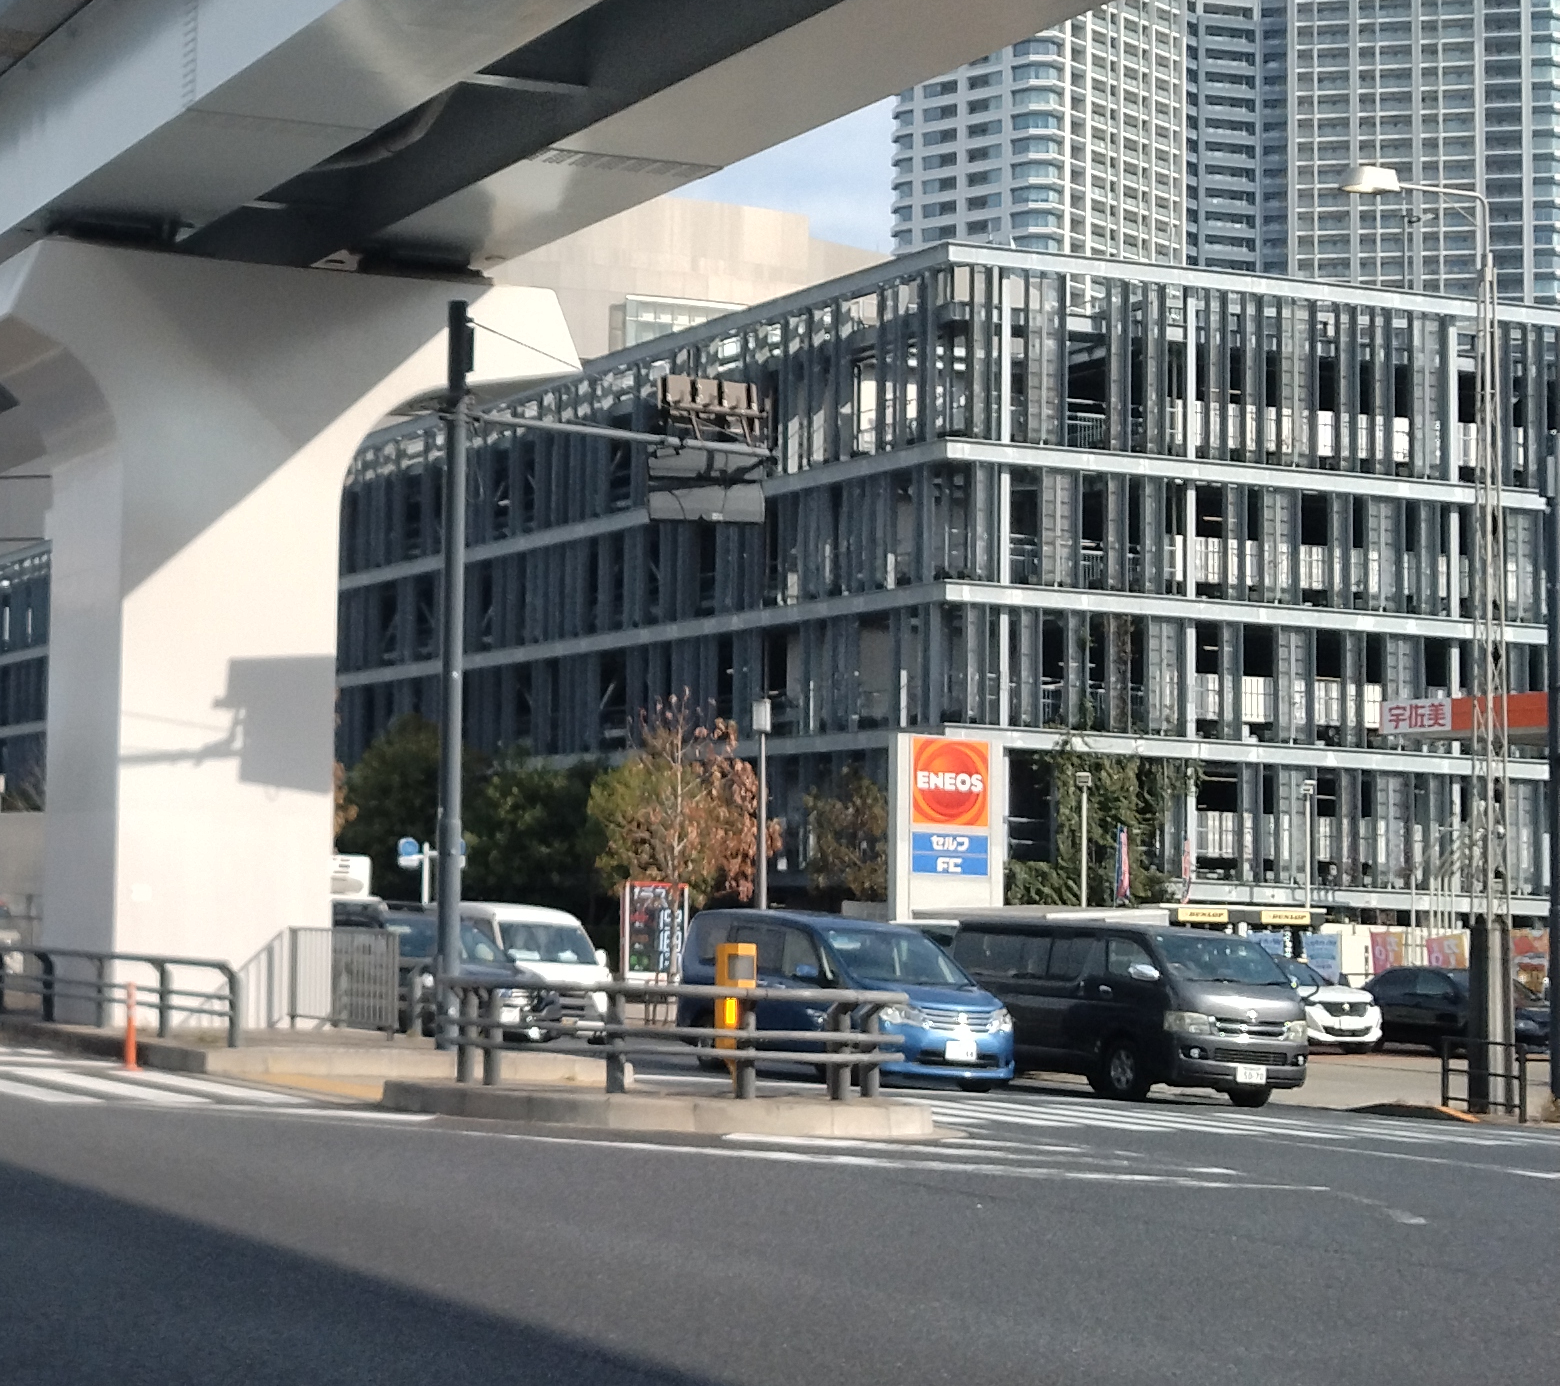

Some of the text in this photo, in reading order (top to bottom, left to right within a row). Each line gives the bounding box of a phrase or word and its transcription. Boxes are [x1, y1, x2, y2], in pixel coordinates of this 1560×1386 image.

[1388, 702, 1446, 729] 宇佐美
[916, 770, 983, 793] ENEOS
[931, 834, 970, 852] セルフ
